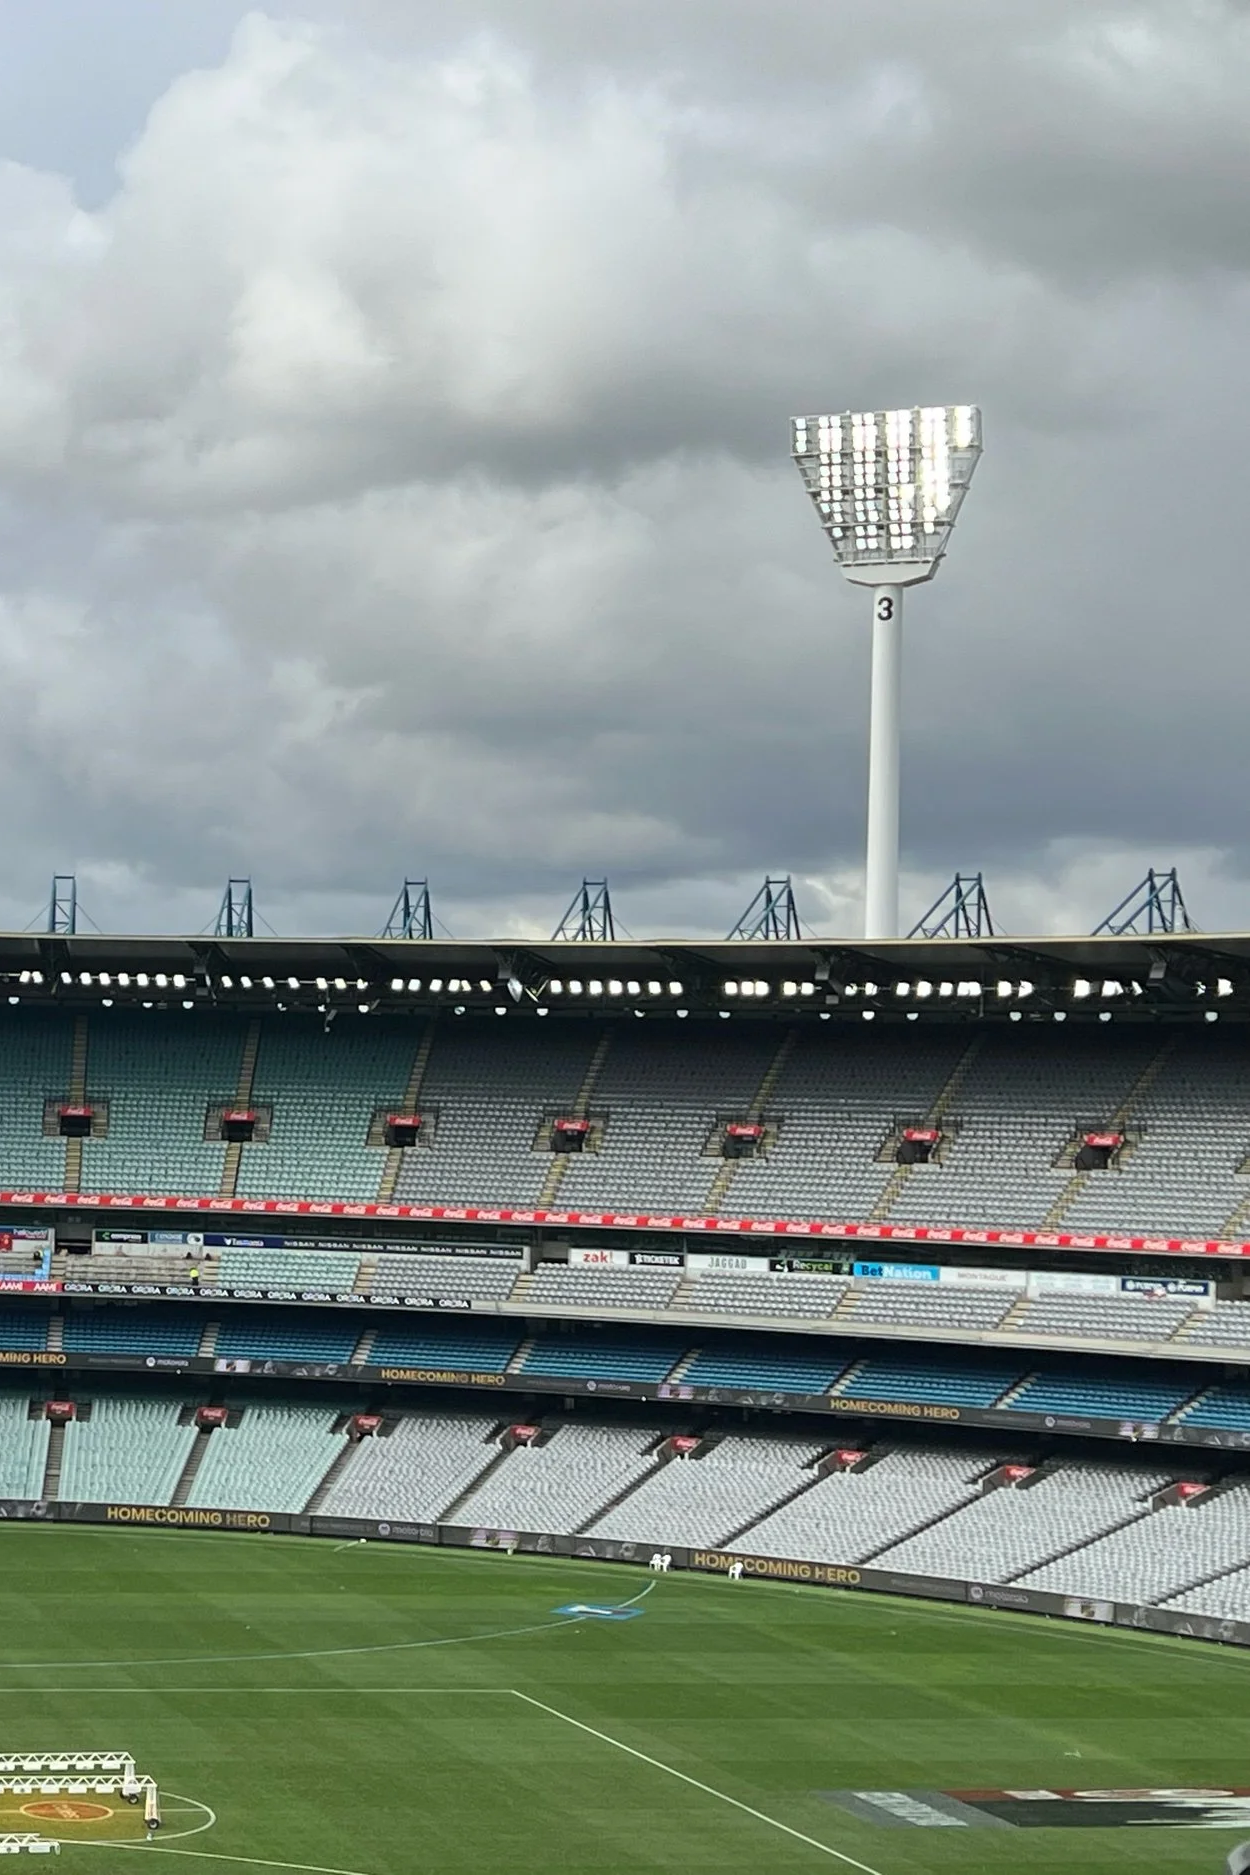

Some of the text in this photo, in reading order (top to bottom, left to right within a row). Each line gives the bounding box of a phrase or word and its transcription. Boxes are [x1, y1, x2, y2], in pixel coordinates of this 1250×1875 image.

[877, 596, 894, 621] 3
[583, 1251, 613, 1264] zak!
[861, 1264, 932, 1280] BetNation
[33, 1354, 67, 1365] HERO
[381, 1368, 506, 1386] HOMECOMING HERO
[830, 1398, 960, 1420] HOMECOMING HERO
[107, 1506, 270, 1528] HOMECOMING HERO
[814, 1567, 861, 1584] HERO
